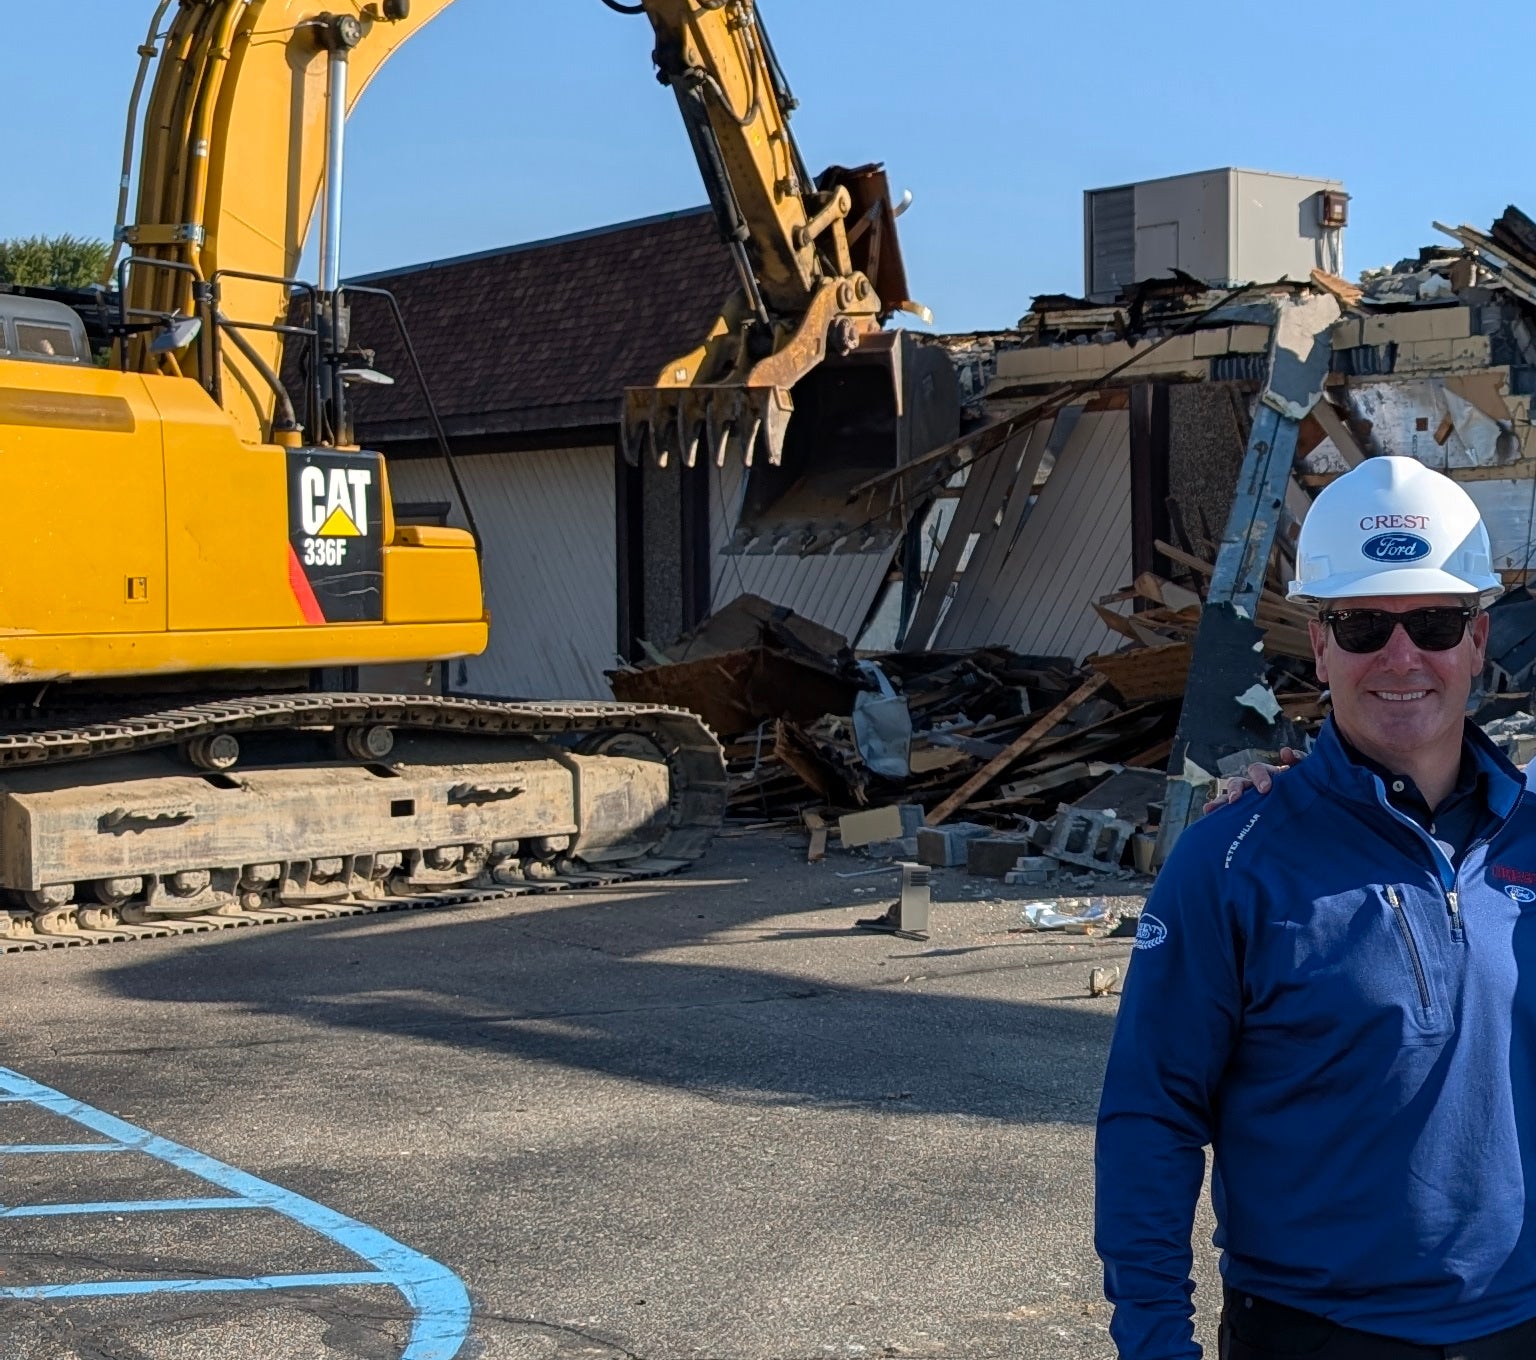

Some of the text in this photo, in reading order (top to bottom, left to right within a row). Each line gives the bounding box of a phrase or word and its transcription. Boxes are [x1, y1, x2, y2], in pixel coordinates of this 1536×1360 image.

[300, 465, 371, 536] CAT
[1360, 515, 1430, 531] CREST
[304, 537, 346, 566] 336F
[1224, 813, 1261, 869] PETER MILLAR
